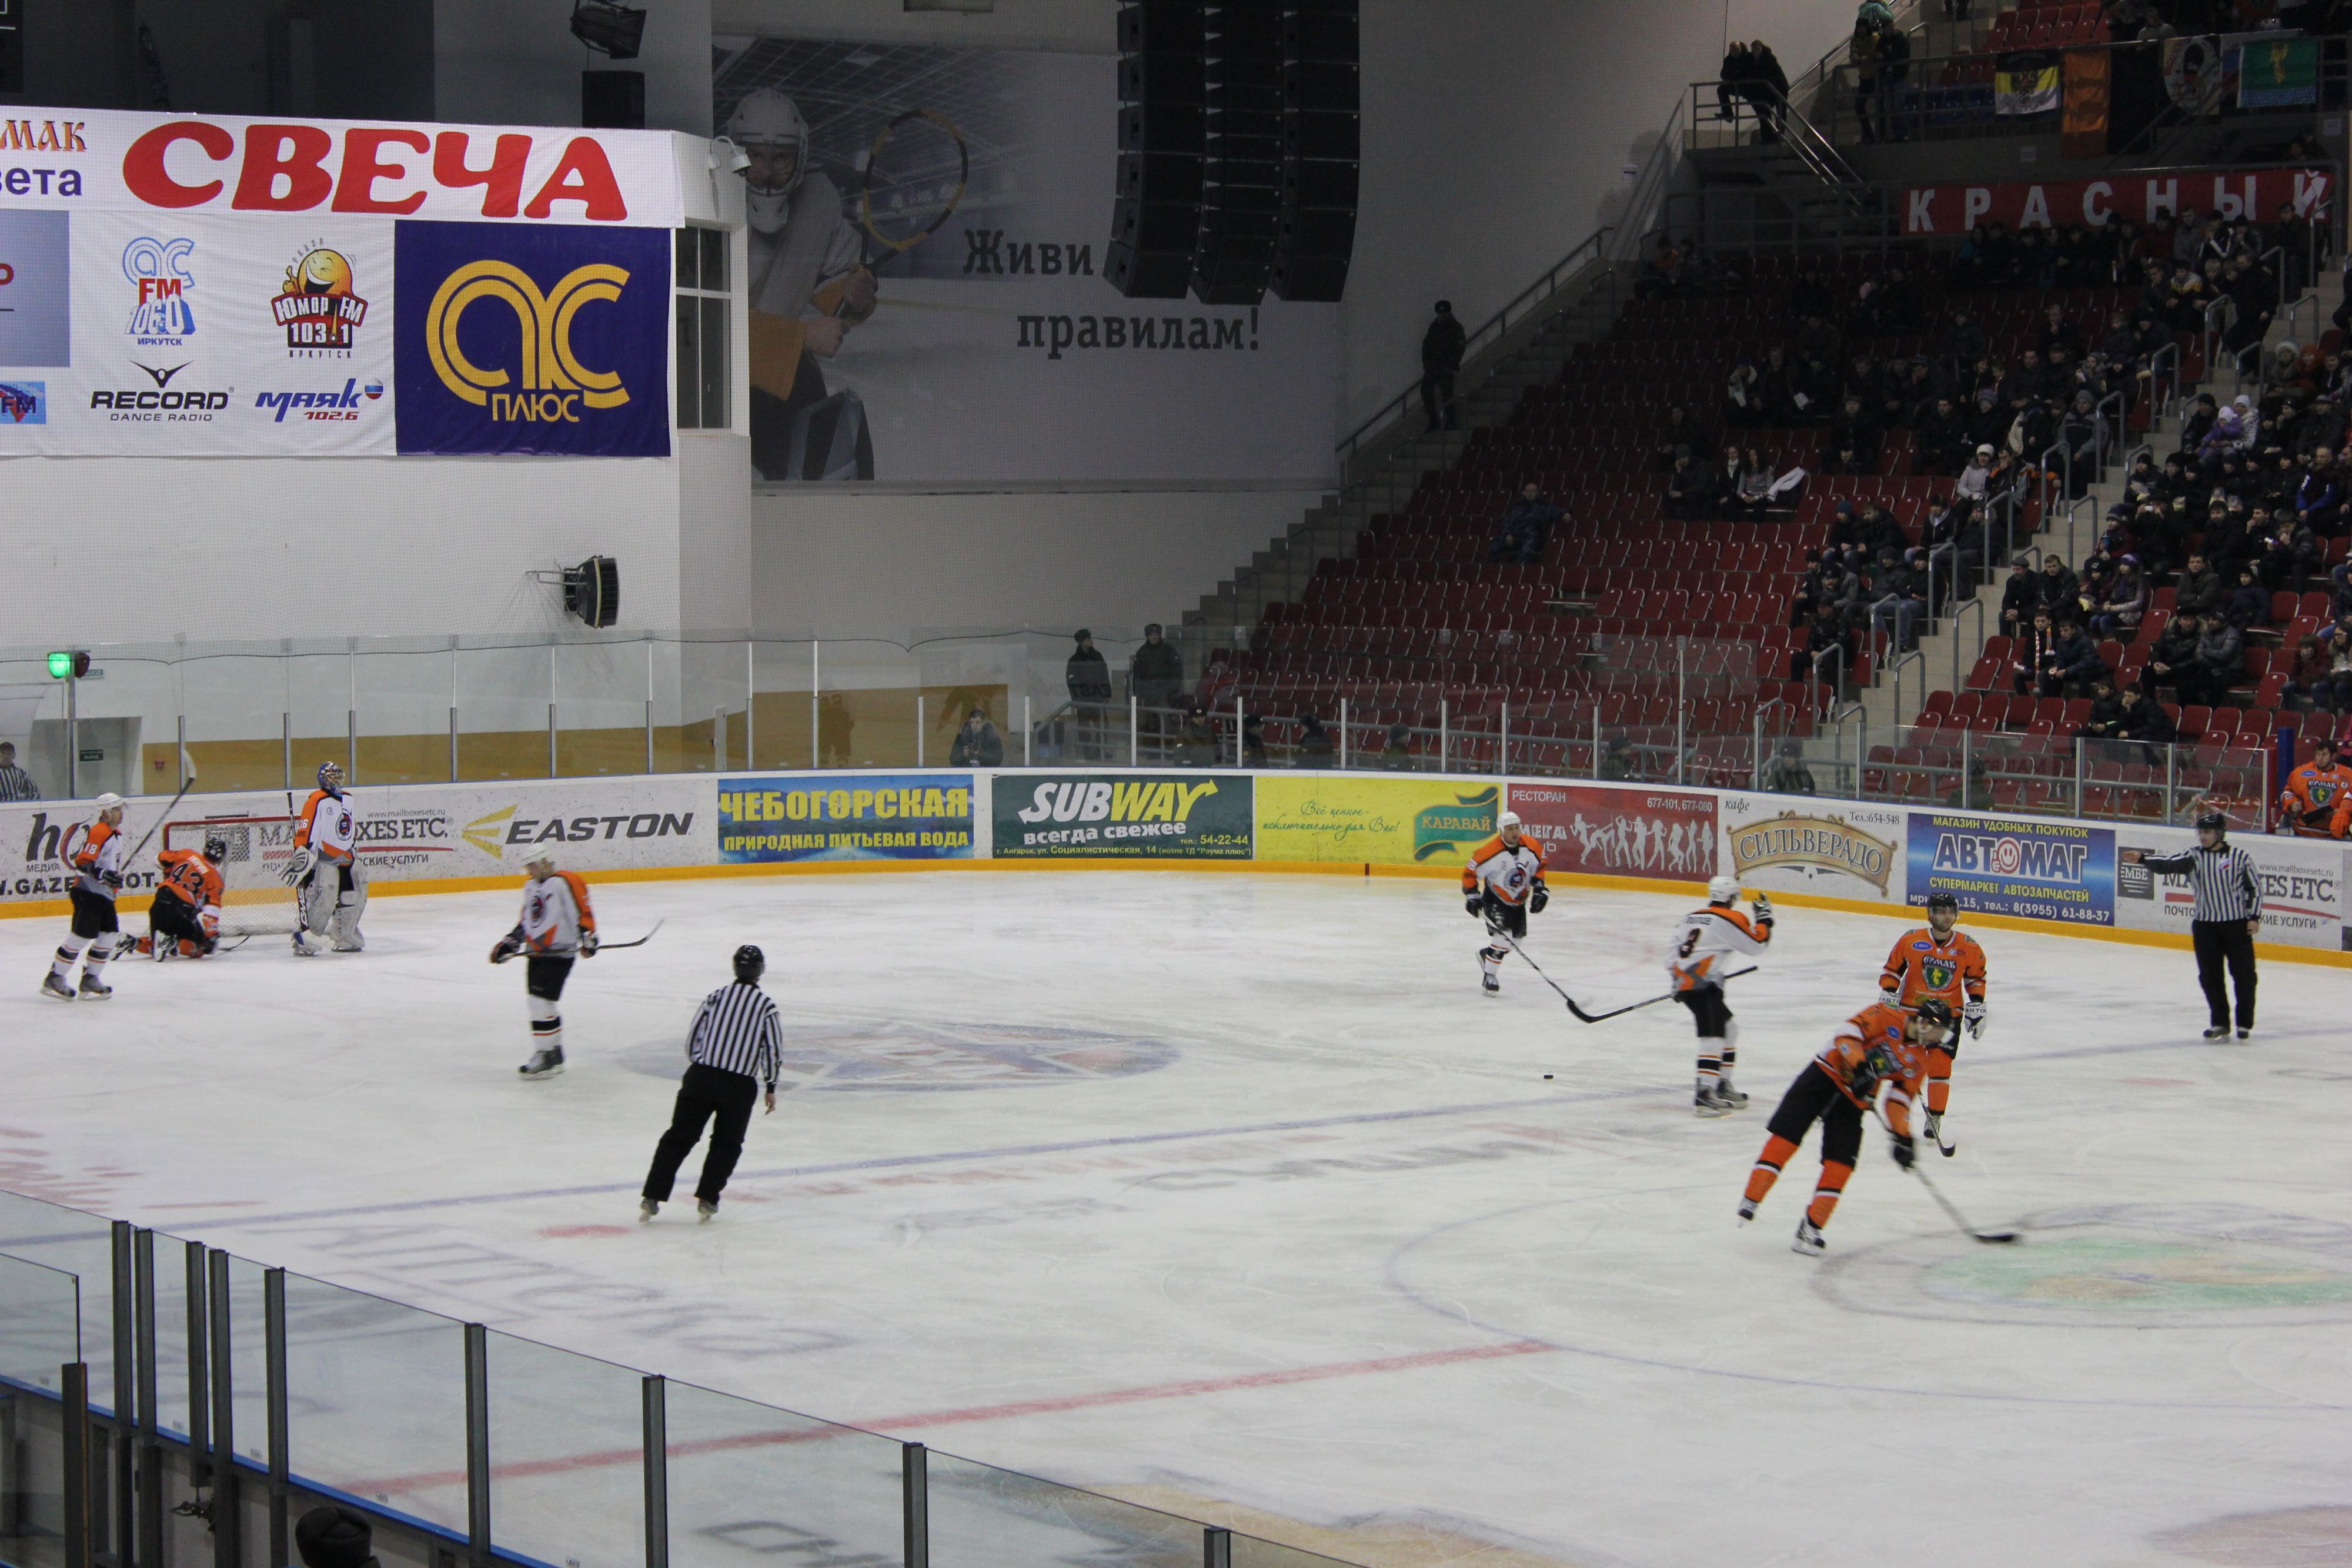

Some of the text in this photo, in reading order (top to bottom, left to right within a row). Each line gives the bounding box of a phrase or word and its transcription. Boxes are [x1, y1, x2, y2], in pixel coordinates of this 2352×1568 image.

[122, 121, 627, 220] СВЕЧА
[0, 168, 83, 196] ета
[1908, 168, 2327, 232] КРАСНЫЙ
[963, 229, 1094, 276] Живи
[139, 278, 182, 306] FM
[339, 296, 364, 323] FM
[137, 337, 183, 346] ИРКУТСК
[1015, 307, 1259, 360] правилам!
[289, 350, 351, 359] ИРКУТСК
[110, 413, 212, 422] DANCE RADIO
[492, 393, 580, 422] ПЛЮС
[720, 788, 968, 821] ЧЕБОГОРСКАЯ
[1018, 779, 1219, 824] SUBWAY
[1512, 790, 1566, 803] РЕСТОРАН
[1647, 797, 1712, 813] 677-101, 677-080
[1725, 800, 1750, 813] кафе
[368, 808, 445, 818] www.mailboxesetc.ru
[1421, 815, 1491, 831] КАРАВАЙ
[505, 813, 694, 845] EASTON
[1024, 822, 1187, 845] всегда свежее
[1262, 814, 1401, 841] исключительно для Вас!
[1933, 815, 2088, 838] МАГАЗИН УДОБНЫХ ПОКУПОК
[84, 842, 98, 854] 18
[724, 832, 969, 851] ПРИРОДНАЯ ПИТЬЕВАЯ ВОДА
[1050, 845, 1142, 855] Социалистическая,
[1200, 834, 1248, 845] 54-22-44
[391, 854, 429, 865] УСЛУГИ
[1739, 828, 1883, 875] СИЛЬВЕРАДО
[26, 864, 61, 873] МЕДИА
[169, 863, 205, 895] 43
[2259, 864, 2333, 877] www.mailboxesetc.ru
[1929, 877, 2089, 902] СУПЕРМАРКЕТ АВТОЗАПЧАСТЕЙ
[1984, 901, 2008, 911] тел.:
[2013, 903, 2057, 918] 8(3955)
[2062, 907, 2110, 922] 61-88-37
[2280, 916, 2316, 928] УСЛУГИ
